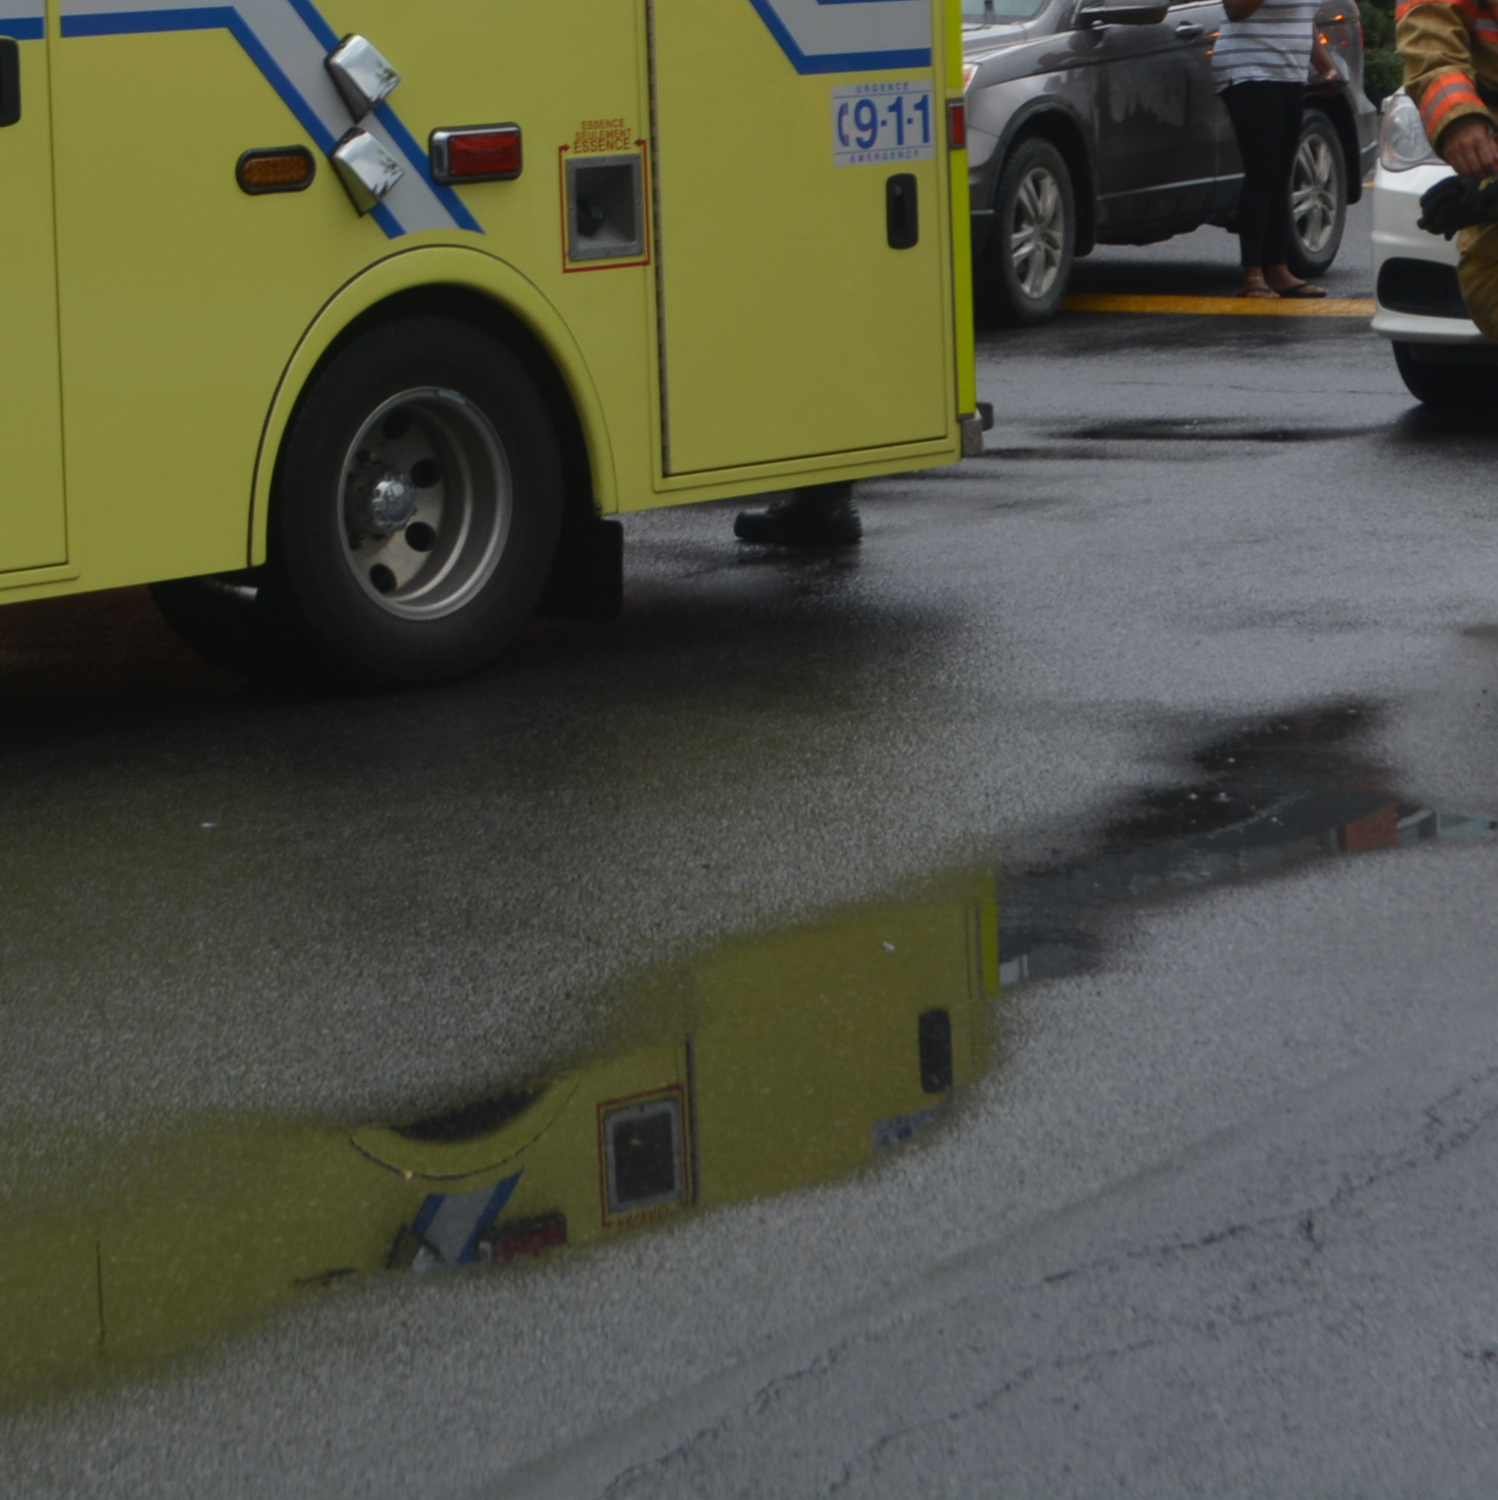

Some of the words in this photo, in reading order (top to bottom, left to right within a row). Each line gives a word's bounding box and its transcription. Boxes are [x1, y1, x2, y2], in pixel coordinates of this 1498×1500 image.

[856, 82, 908, 93] URGENCE
[582, 118, 625, 130] ESSENCE
[575, 128, 632, 140] SEULEMENT
[574, 137, 631, 153] ESSENCE
[850, 150, 919, 163] EMERGENCY
